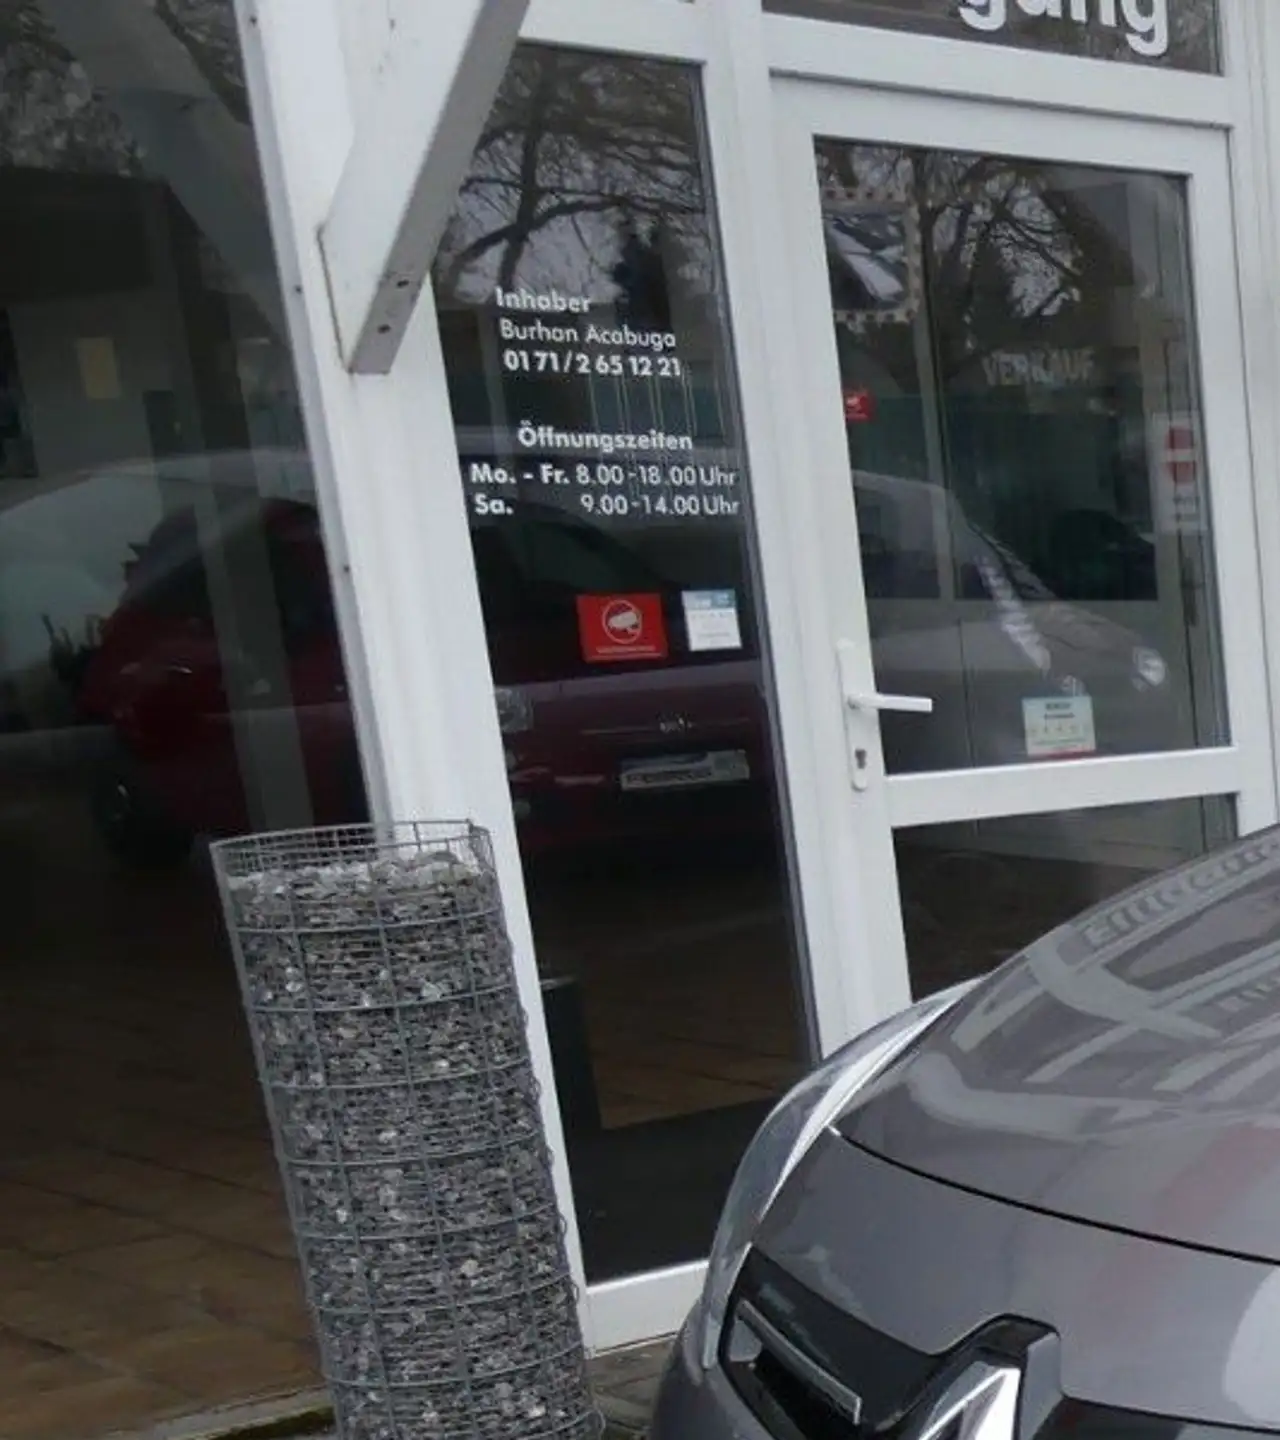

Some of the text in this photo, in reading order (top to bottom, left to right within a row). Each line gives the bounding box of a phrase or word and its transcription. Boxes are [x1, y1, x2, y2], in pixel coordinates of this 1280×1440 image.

[495, 286, 591, 312] Inhaber
[500, 318, 677, 351] Burhan Acabuga
[517, 420, 694, 454] Öffnungszeiten
[469, 463, 517, 485] Mo.
[540, 465, 570, 485] Fr.
[699, 467, 738, 487] Uhr
[474, 493, 515, 515] Sa.
[702, 496, 741, 516] Uhr
